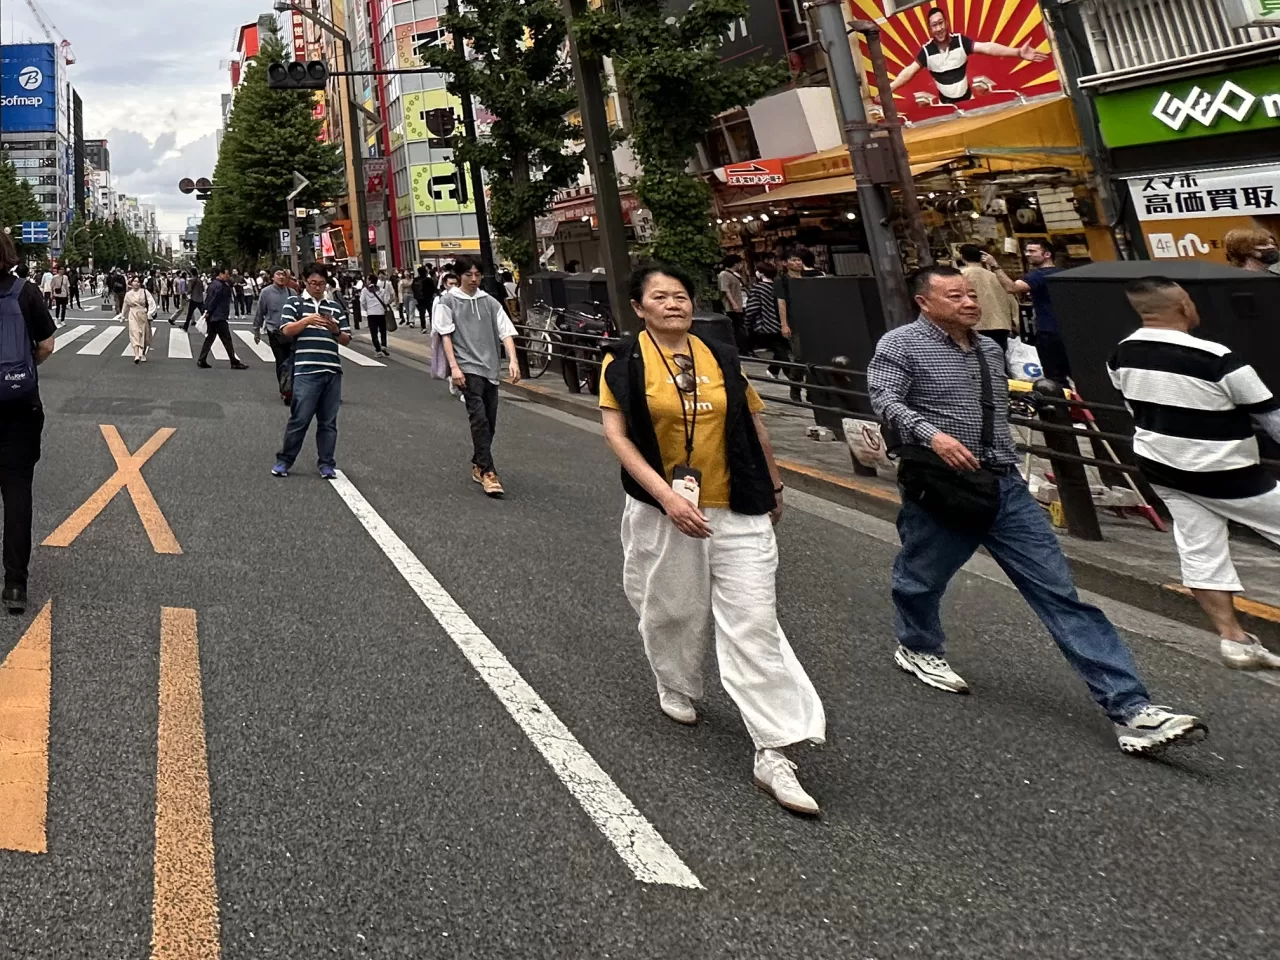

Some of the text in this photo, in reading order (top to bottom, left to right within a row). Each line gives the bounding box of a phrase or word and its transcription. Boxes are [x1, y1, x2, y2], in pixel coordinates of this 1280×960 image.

[1141, 174, 1198, 191] スマホ
[1142, 185, 1278, 215] 高価買取
[1155, 238, 1173, 254] 4F
